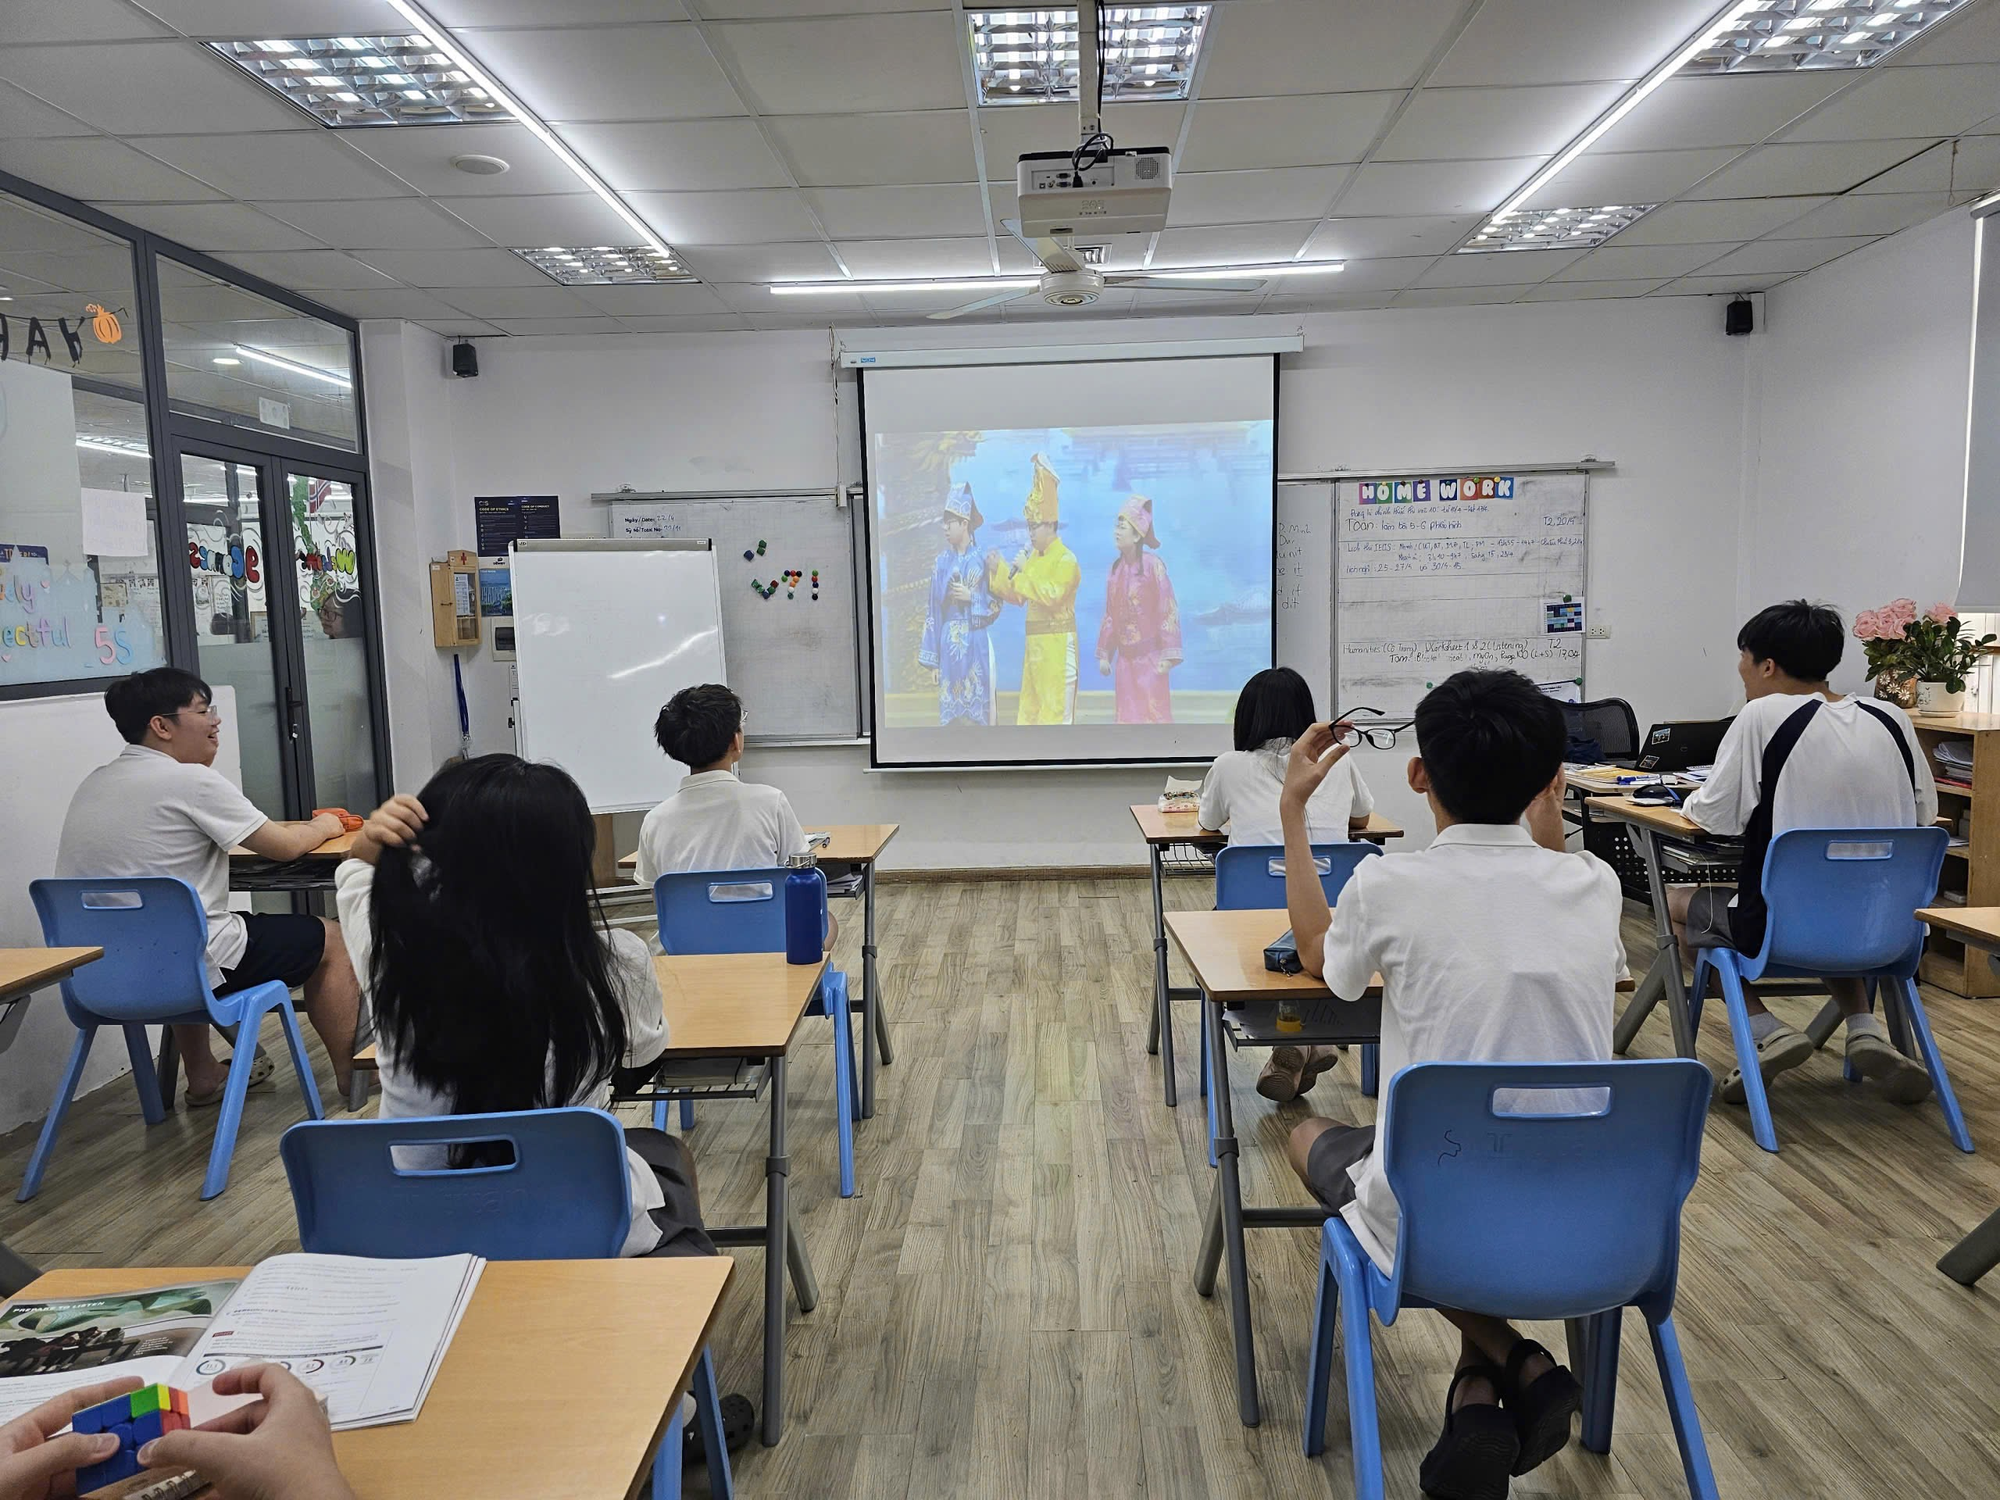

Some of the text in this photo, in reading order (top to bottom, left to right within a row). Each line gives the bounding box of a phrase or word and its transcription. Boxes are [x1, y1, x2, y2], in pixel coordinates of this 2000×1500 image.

[1361, 479, 1511, 501] HOME WORK
[72, 1301, 105, 1309] LISTEN
